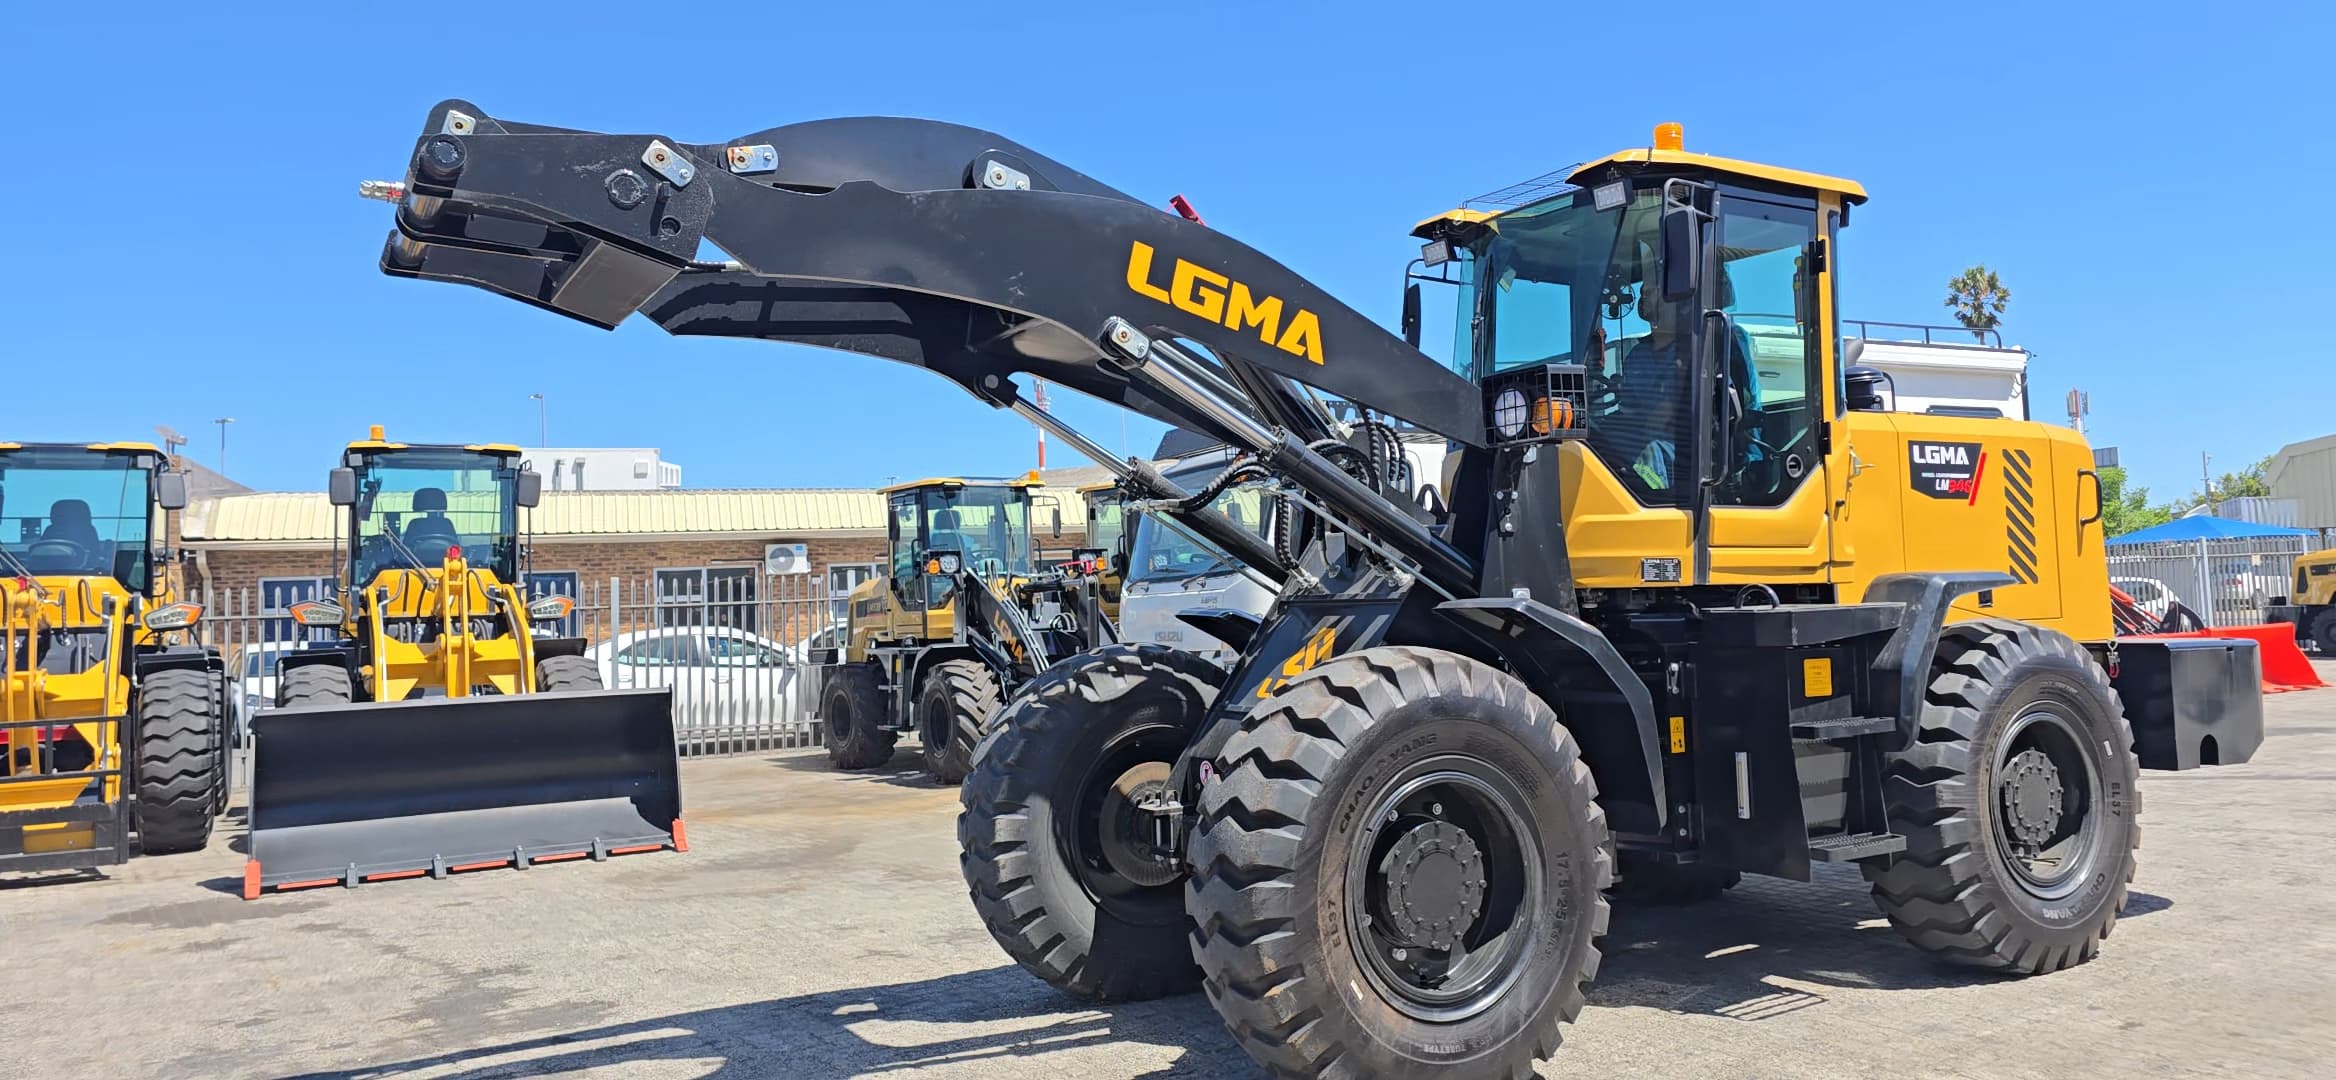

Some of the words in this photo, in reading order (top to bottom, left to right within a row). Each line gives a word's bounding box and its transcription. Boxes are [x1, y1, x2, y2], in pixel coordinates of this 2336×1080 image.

[1126, 239, 1325, 366] LGMA
[1912, 444, 1970, 465] LGMA
[1154, 630, 1184, 642] ISUZU
[2110, 782, 2121, 817] EL37
[1327, 899, 1342, 948] EL37
